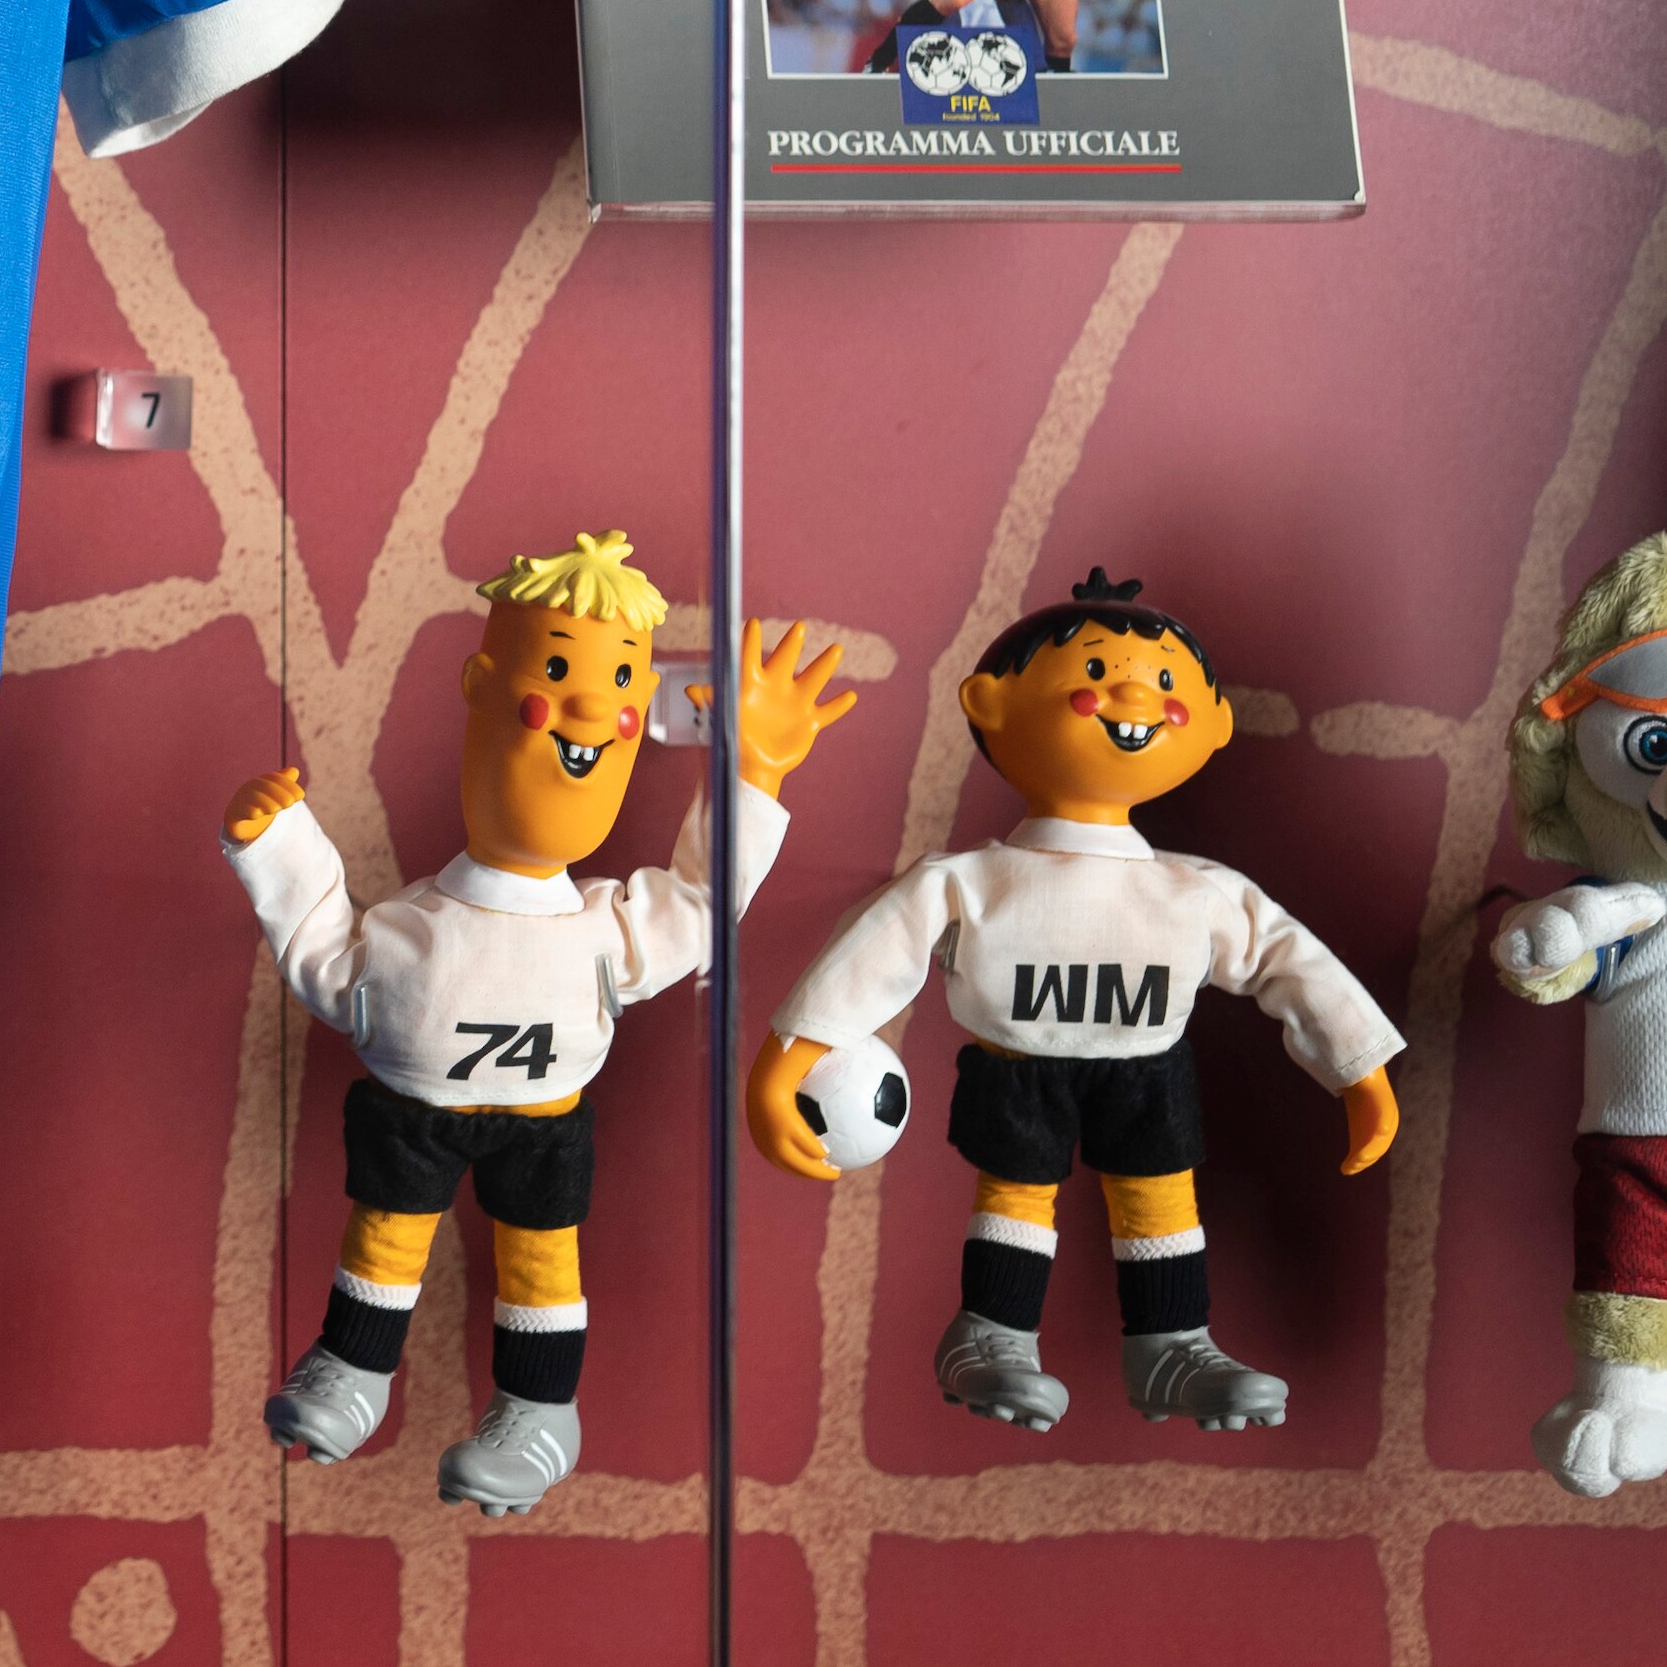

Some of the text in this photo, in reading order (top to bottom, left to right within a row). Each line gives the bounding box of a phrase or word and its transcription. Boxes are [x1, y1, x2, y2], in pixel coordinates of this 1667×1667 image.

[950, 95, 991, 112] FIFA
[767, 129, 1180, 157] PROGRAMMA UFFICIALE
[141, 392, 160, 429] 7
[1010, 963, 1168, 1028] WM
[445, 1022, 558, 1082] 74
